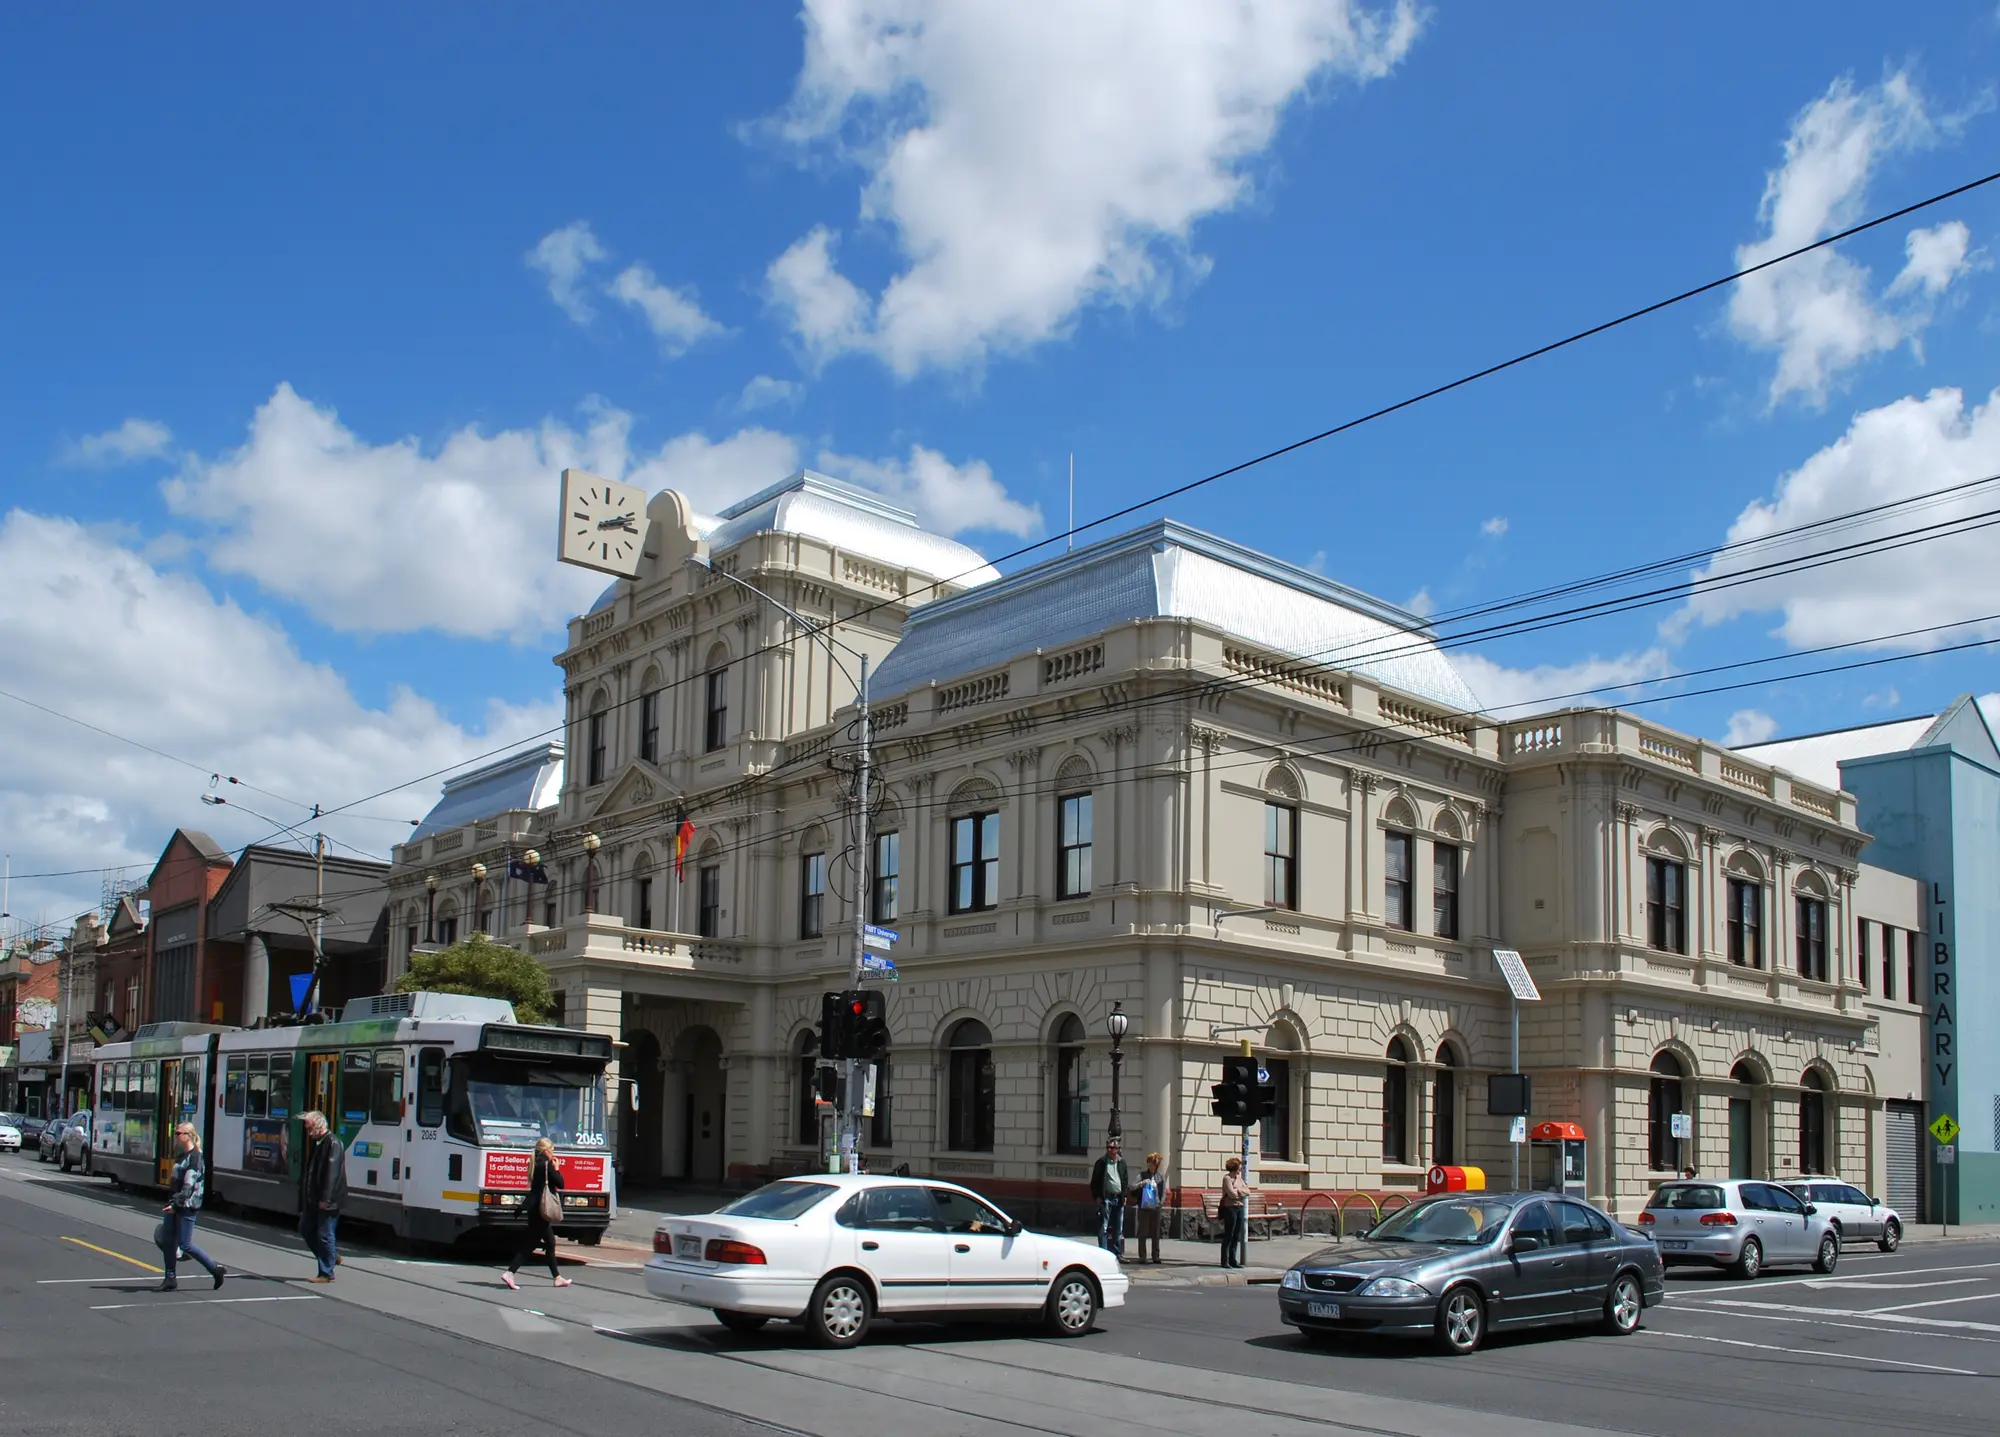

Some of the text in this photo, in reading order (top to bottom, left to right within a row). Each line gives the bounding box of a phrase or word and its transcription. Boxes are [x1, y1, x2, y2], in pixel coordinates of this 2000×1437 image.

[864, 969, 886, 979] SYDNEY
[1934, 882, 1952, 1086] LIBRARY
[421, 1129, 437, 1140] 2065
[575, 1133, 604, 1145] 2065
[489, 1155, 505, 1163] Basil
[505, 1156, 525, 1164] Sellers
[489, 1163, 497, 1171] 15
